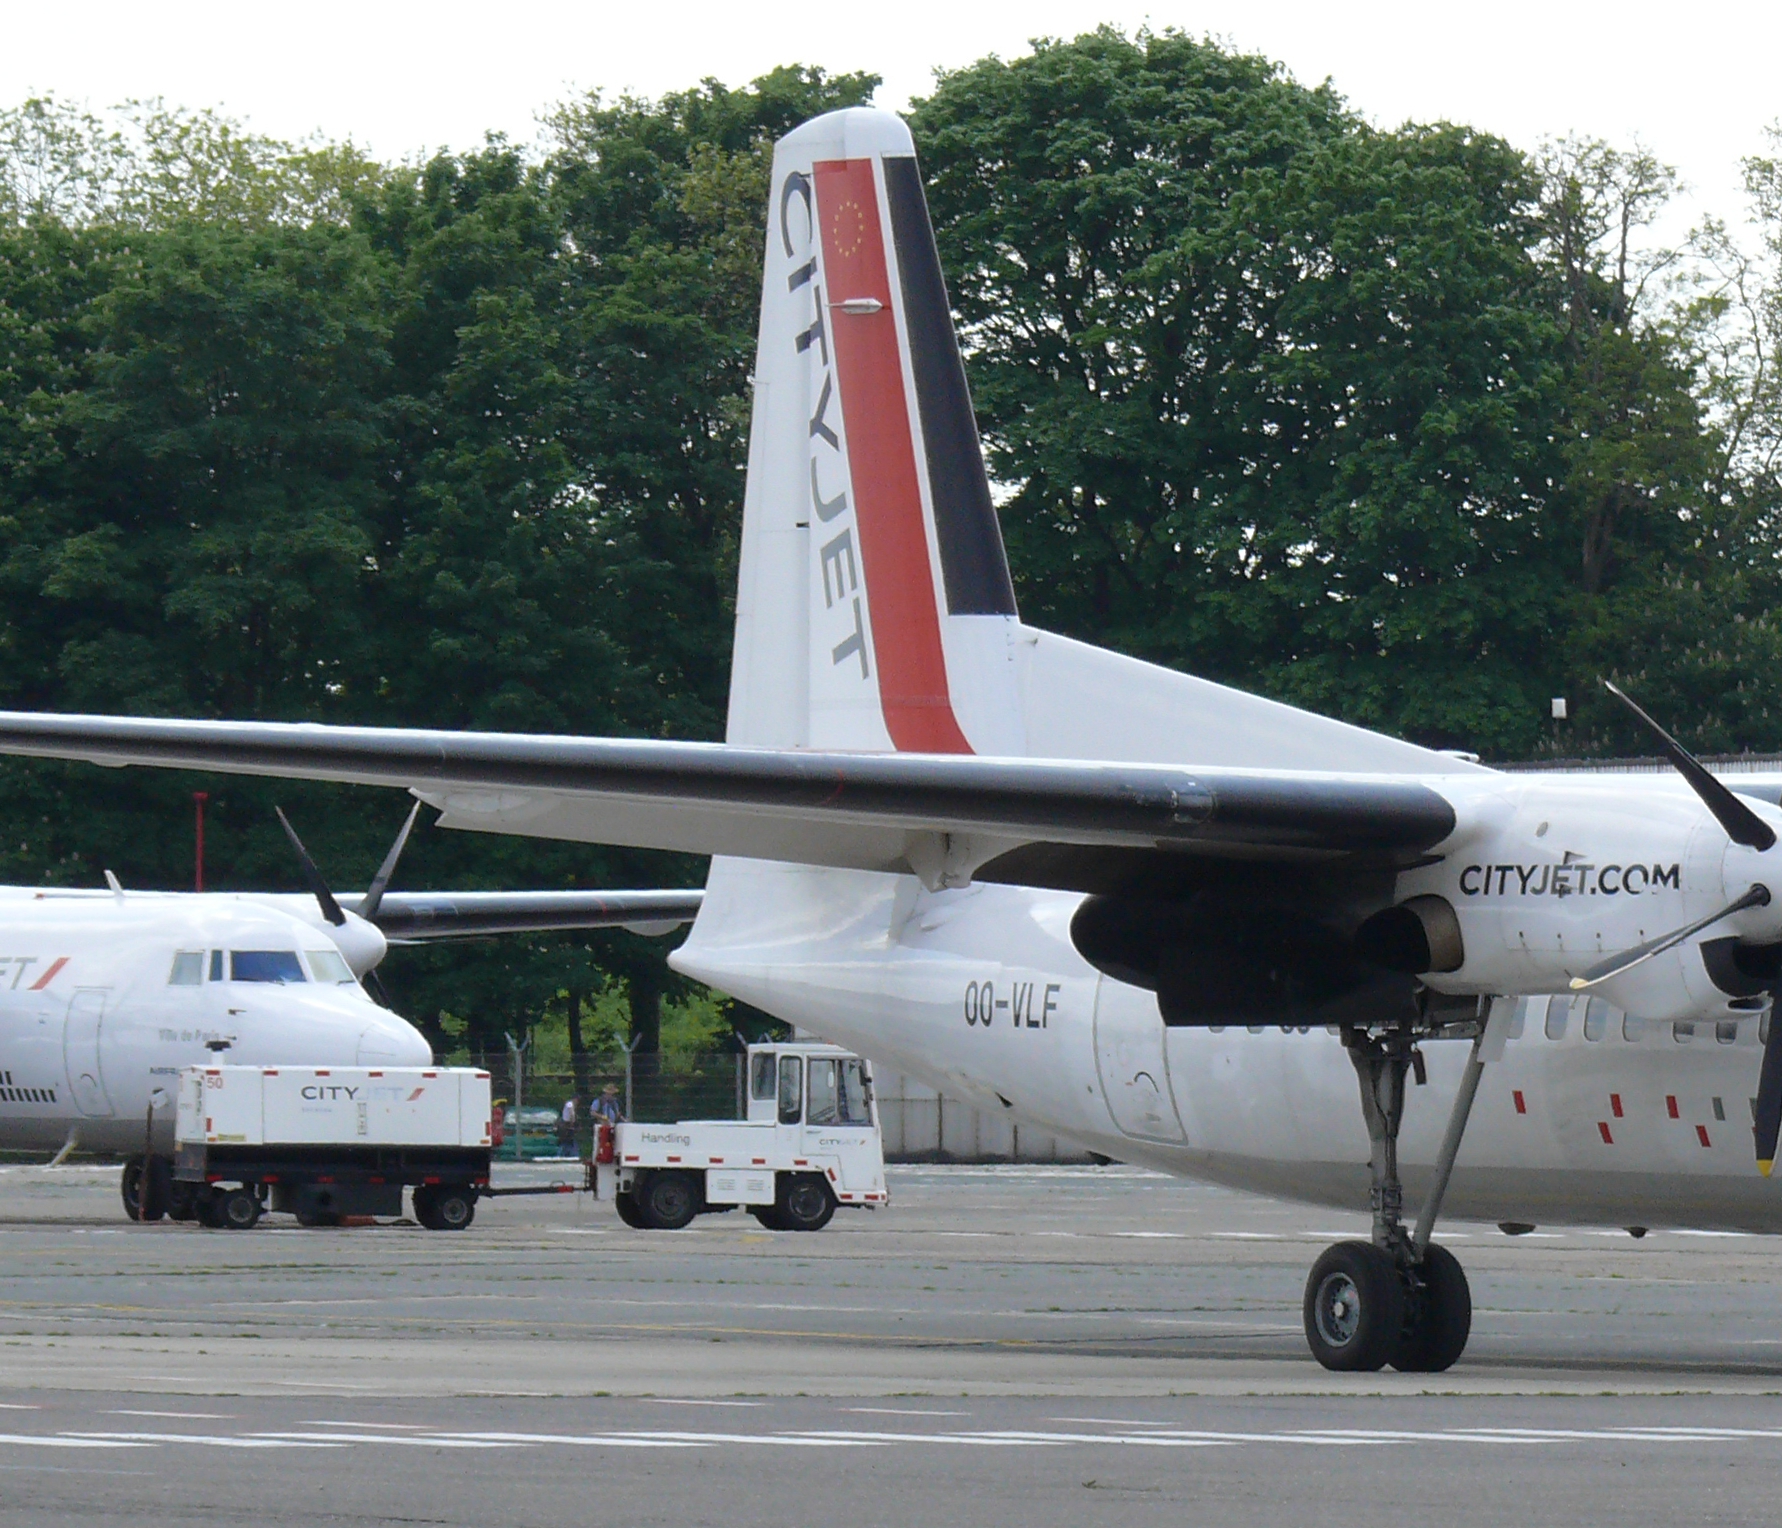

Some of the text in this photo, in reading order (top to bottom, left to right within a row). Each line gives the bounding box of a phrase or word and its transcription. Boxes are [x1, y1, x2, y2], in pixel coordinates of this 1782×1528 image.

[780, 170, 869, 681] CITYJET
[1458, 863, 1680, 896] CITYJET.COM
[964, 980, 1061, 1029] OO-VLF
[206, 1076, 224, 1090] 50
[300, 1085, 405, 1101] CITYJET
[641, 1132, 691, 1146] Handling
